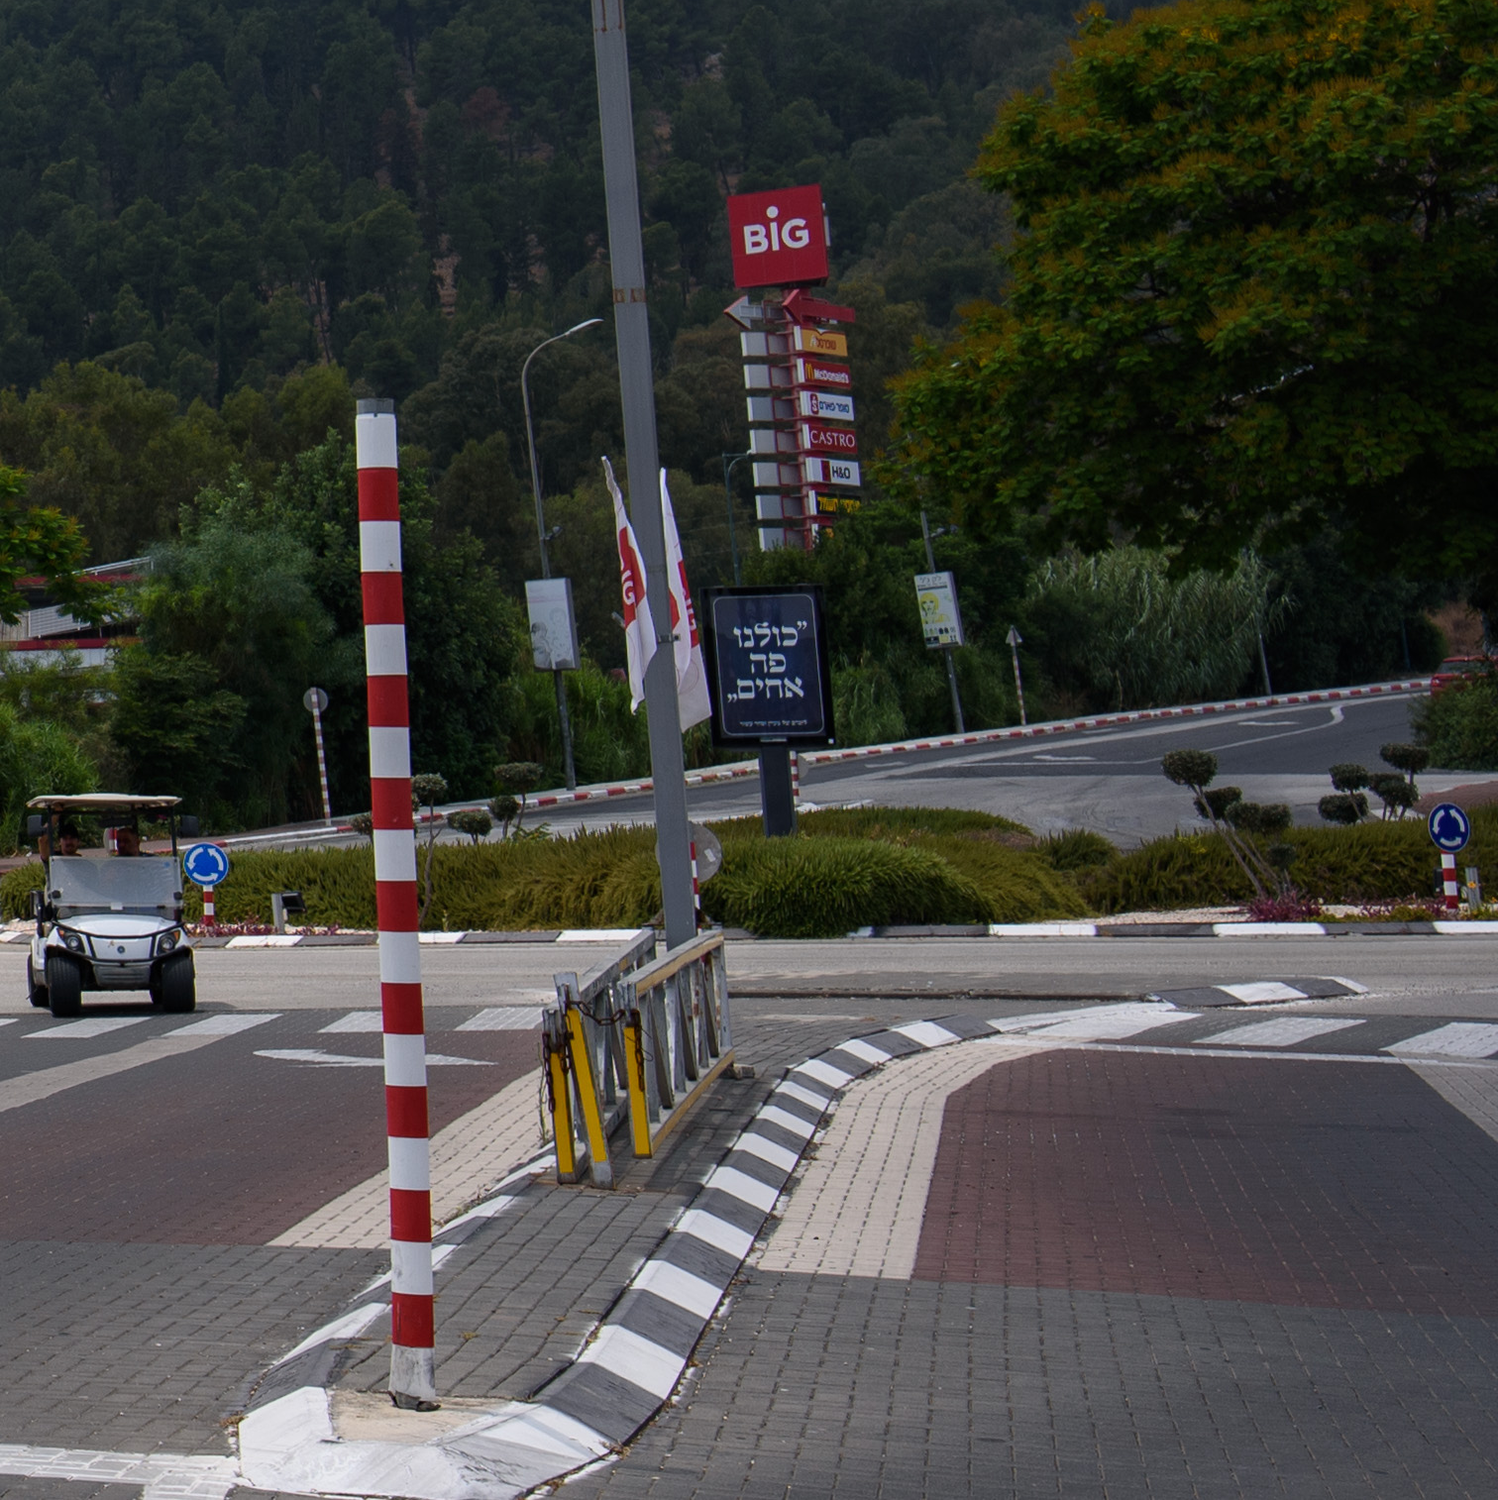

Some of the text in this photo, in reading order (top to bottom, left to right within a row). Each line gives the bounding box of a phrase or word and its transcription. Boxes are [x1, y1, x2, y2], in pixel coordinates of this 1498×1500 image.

[810, 430, 856, 448] CASTRO
[831, 465, 851, 480] H&O
[749, 651, 787, 675] פה
